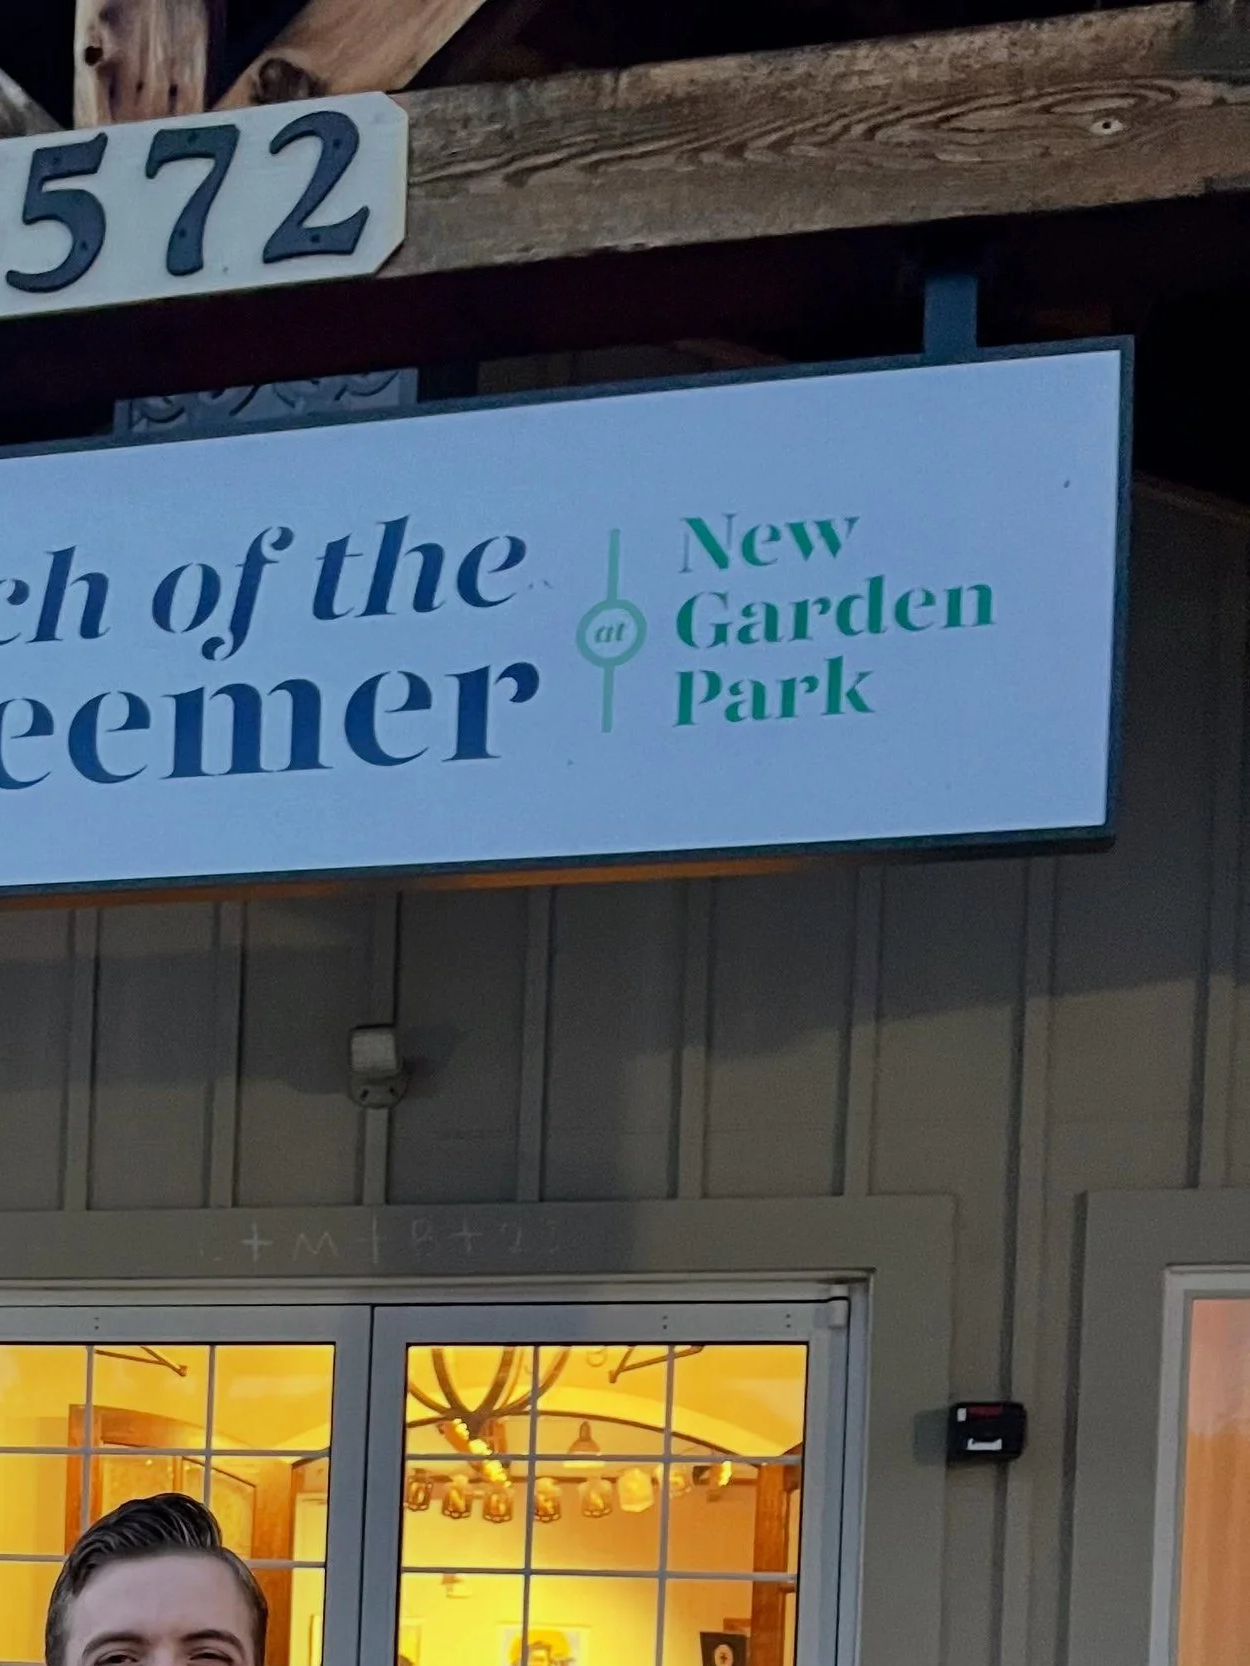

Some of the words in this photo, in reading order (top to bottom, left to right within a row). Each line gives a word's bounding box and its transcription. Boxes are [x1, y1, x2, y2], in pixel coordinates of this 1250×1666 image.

[682, 512, 860, 573] New
[151, 526, 296, 661] of
[313, 515, 527, 621] the
[676, 574, 996, 649] Garden
[593, 620, 626, 646] at
[672, 656, 876, 727] Park
